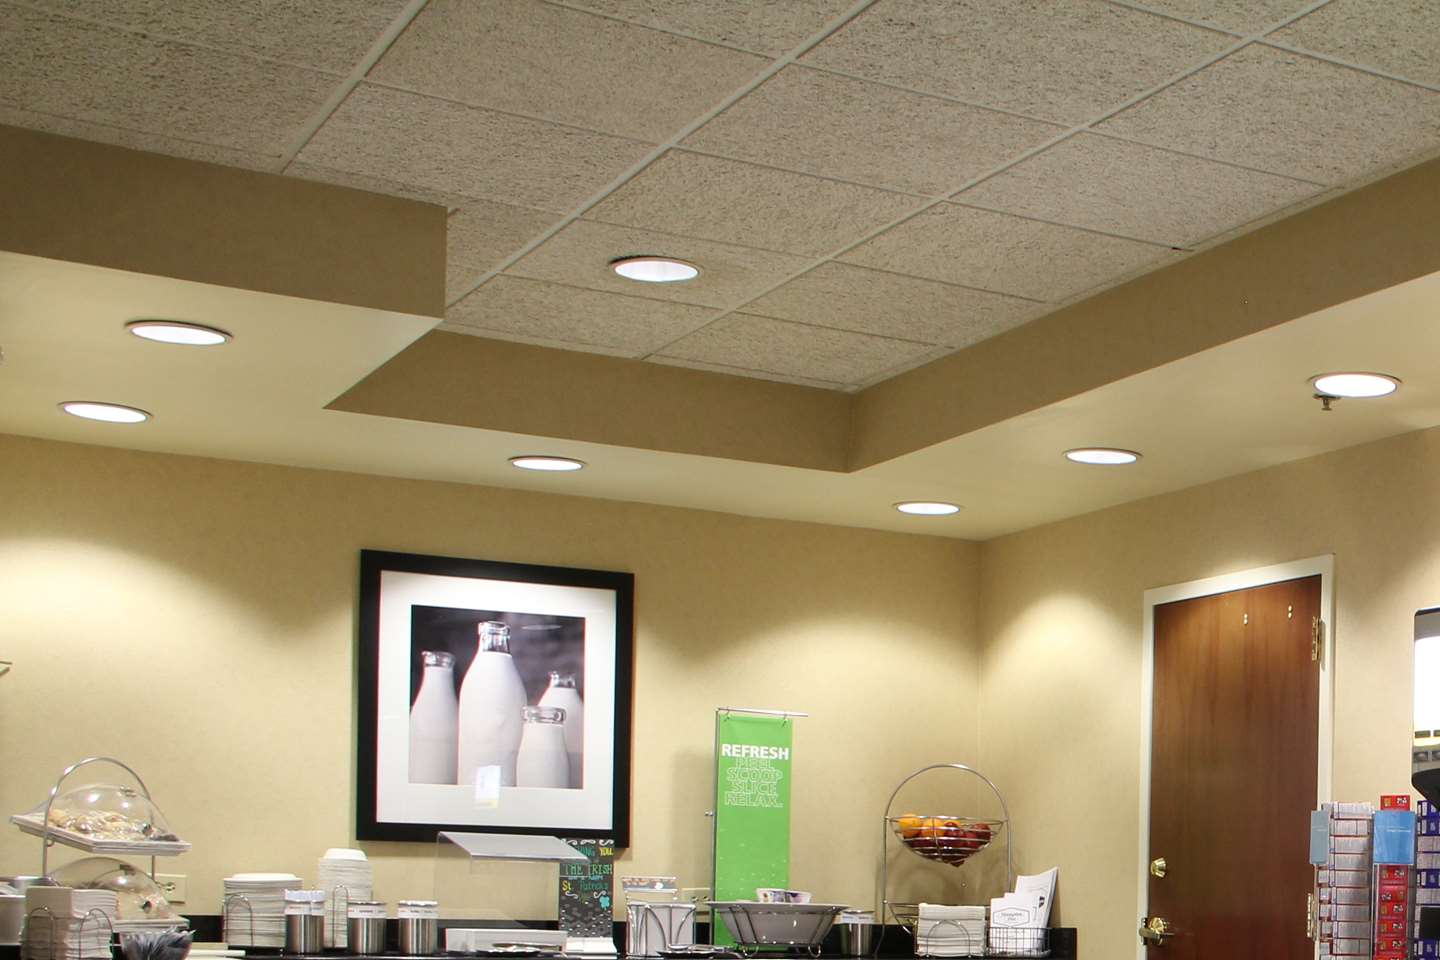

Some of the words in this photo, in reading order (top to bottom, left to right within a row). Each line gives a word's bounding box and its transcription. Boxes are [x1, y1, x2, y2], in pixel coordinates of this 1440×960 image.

[721, 743, 789, 760] REFRESH
[726, 767, 784, 783] SCOOP
[729, 780, 777, 794] SLICE
